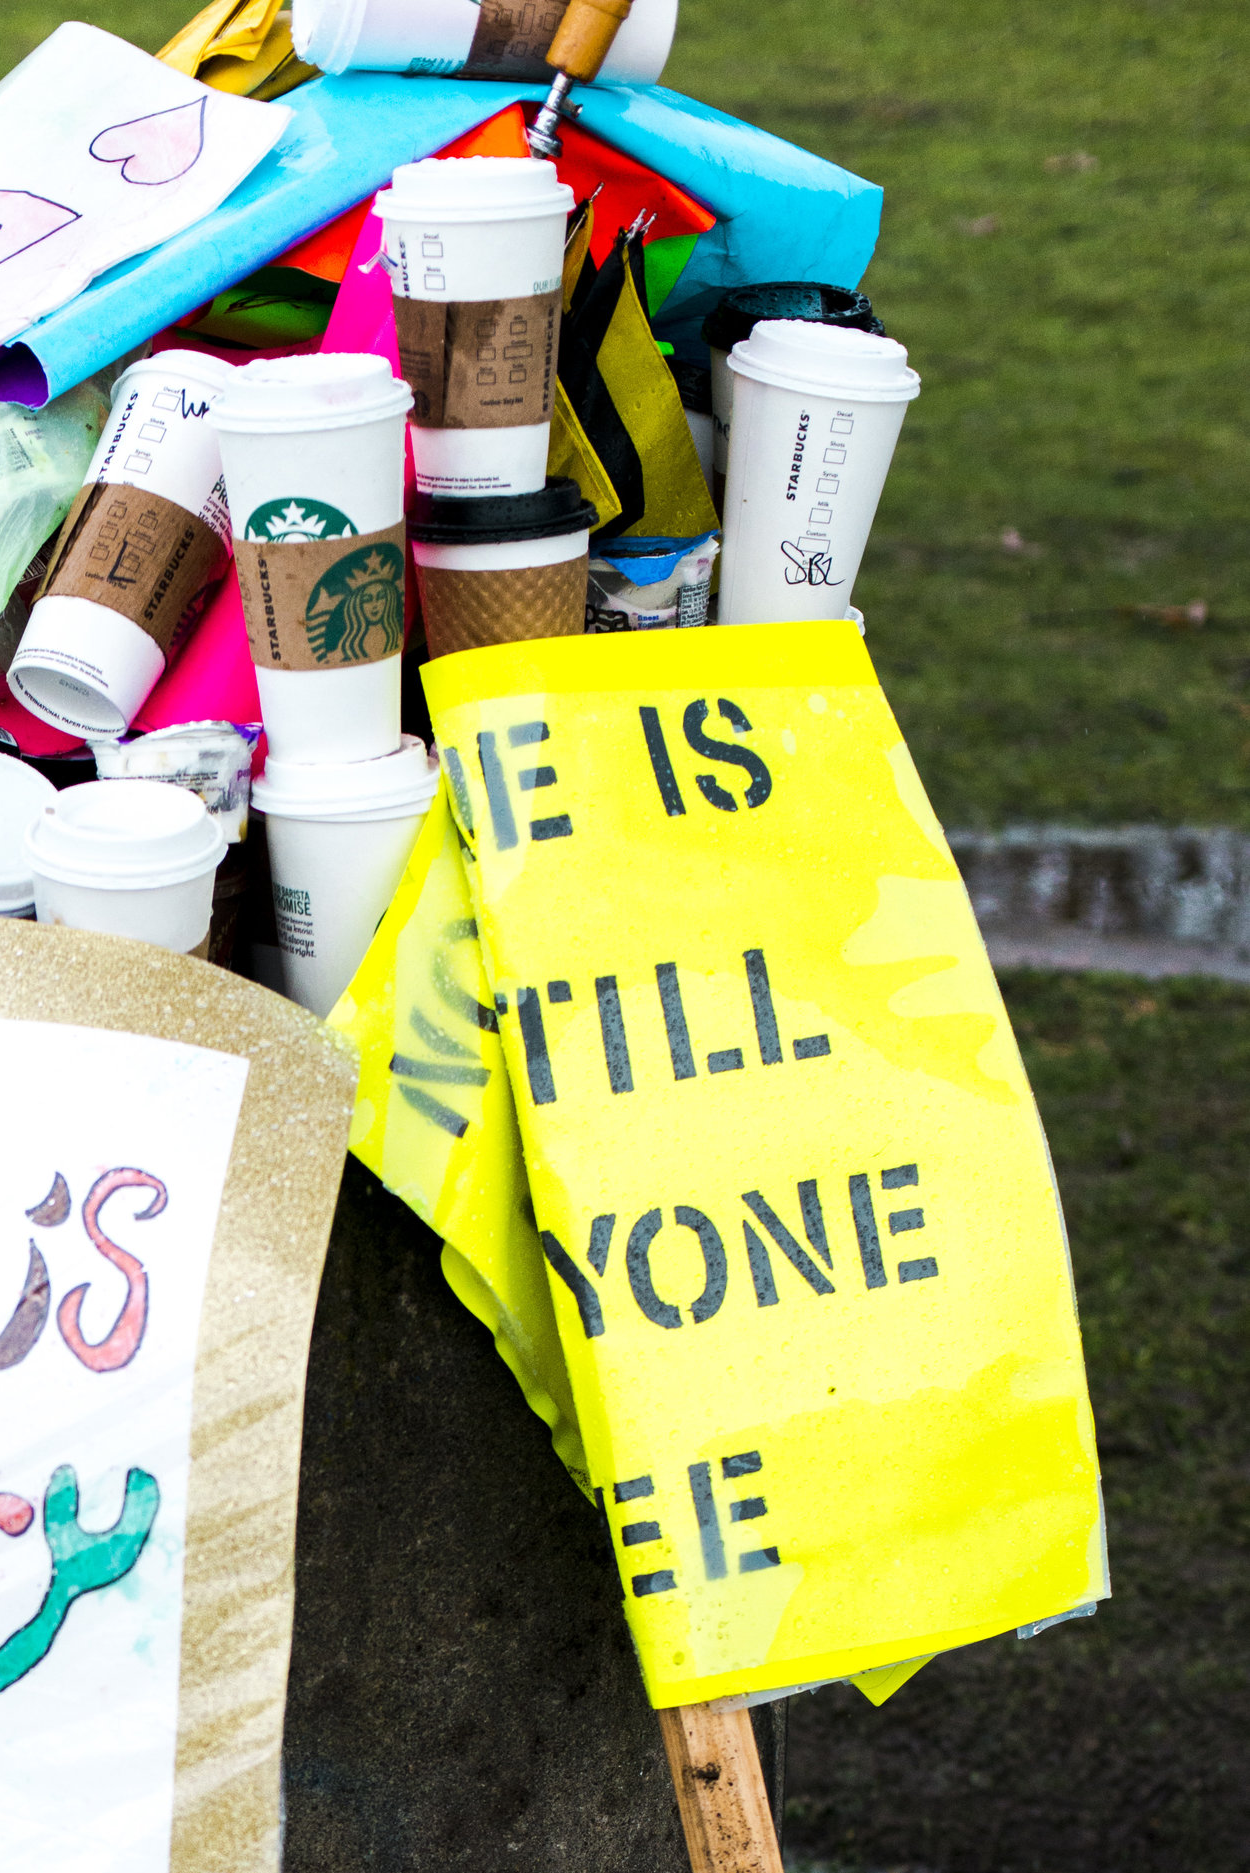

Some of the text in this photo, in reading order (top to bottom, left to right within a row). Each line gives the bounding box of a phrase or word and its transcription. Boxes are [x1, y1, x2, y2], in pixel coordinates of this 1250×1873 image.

[399, 240, 411, 298] BUCKS
[97, 391, 140, 483] STARBUCKS
[786, 411, 811, 501] STARBUCKS
[822, 470, 838, 479] Syrup
[143, 528, 196, 621] STARBUCKS
[806, 530, 827, 538] Custom
[258, 557, 281, 661] STARBUCKS
[24, 690, 61, 720] INTERNATIONAL
[62, 717, 81, 728] PAPER
[638, 697, 773, 817] IS
[538, 1163, 939, 1340] YONE
